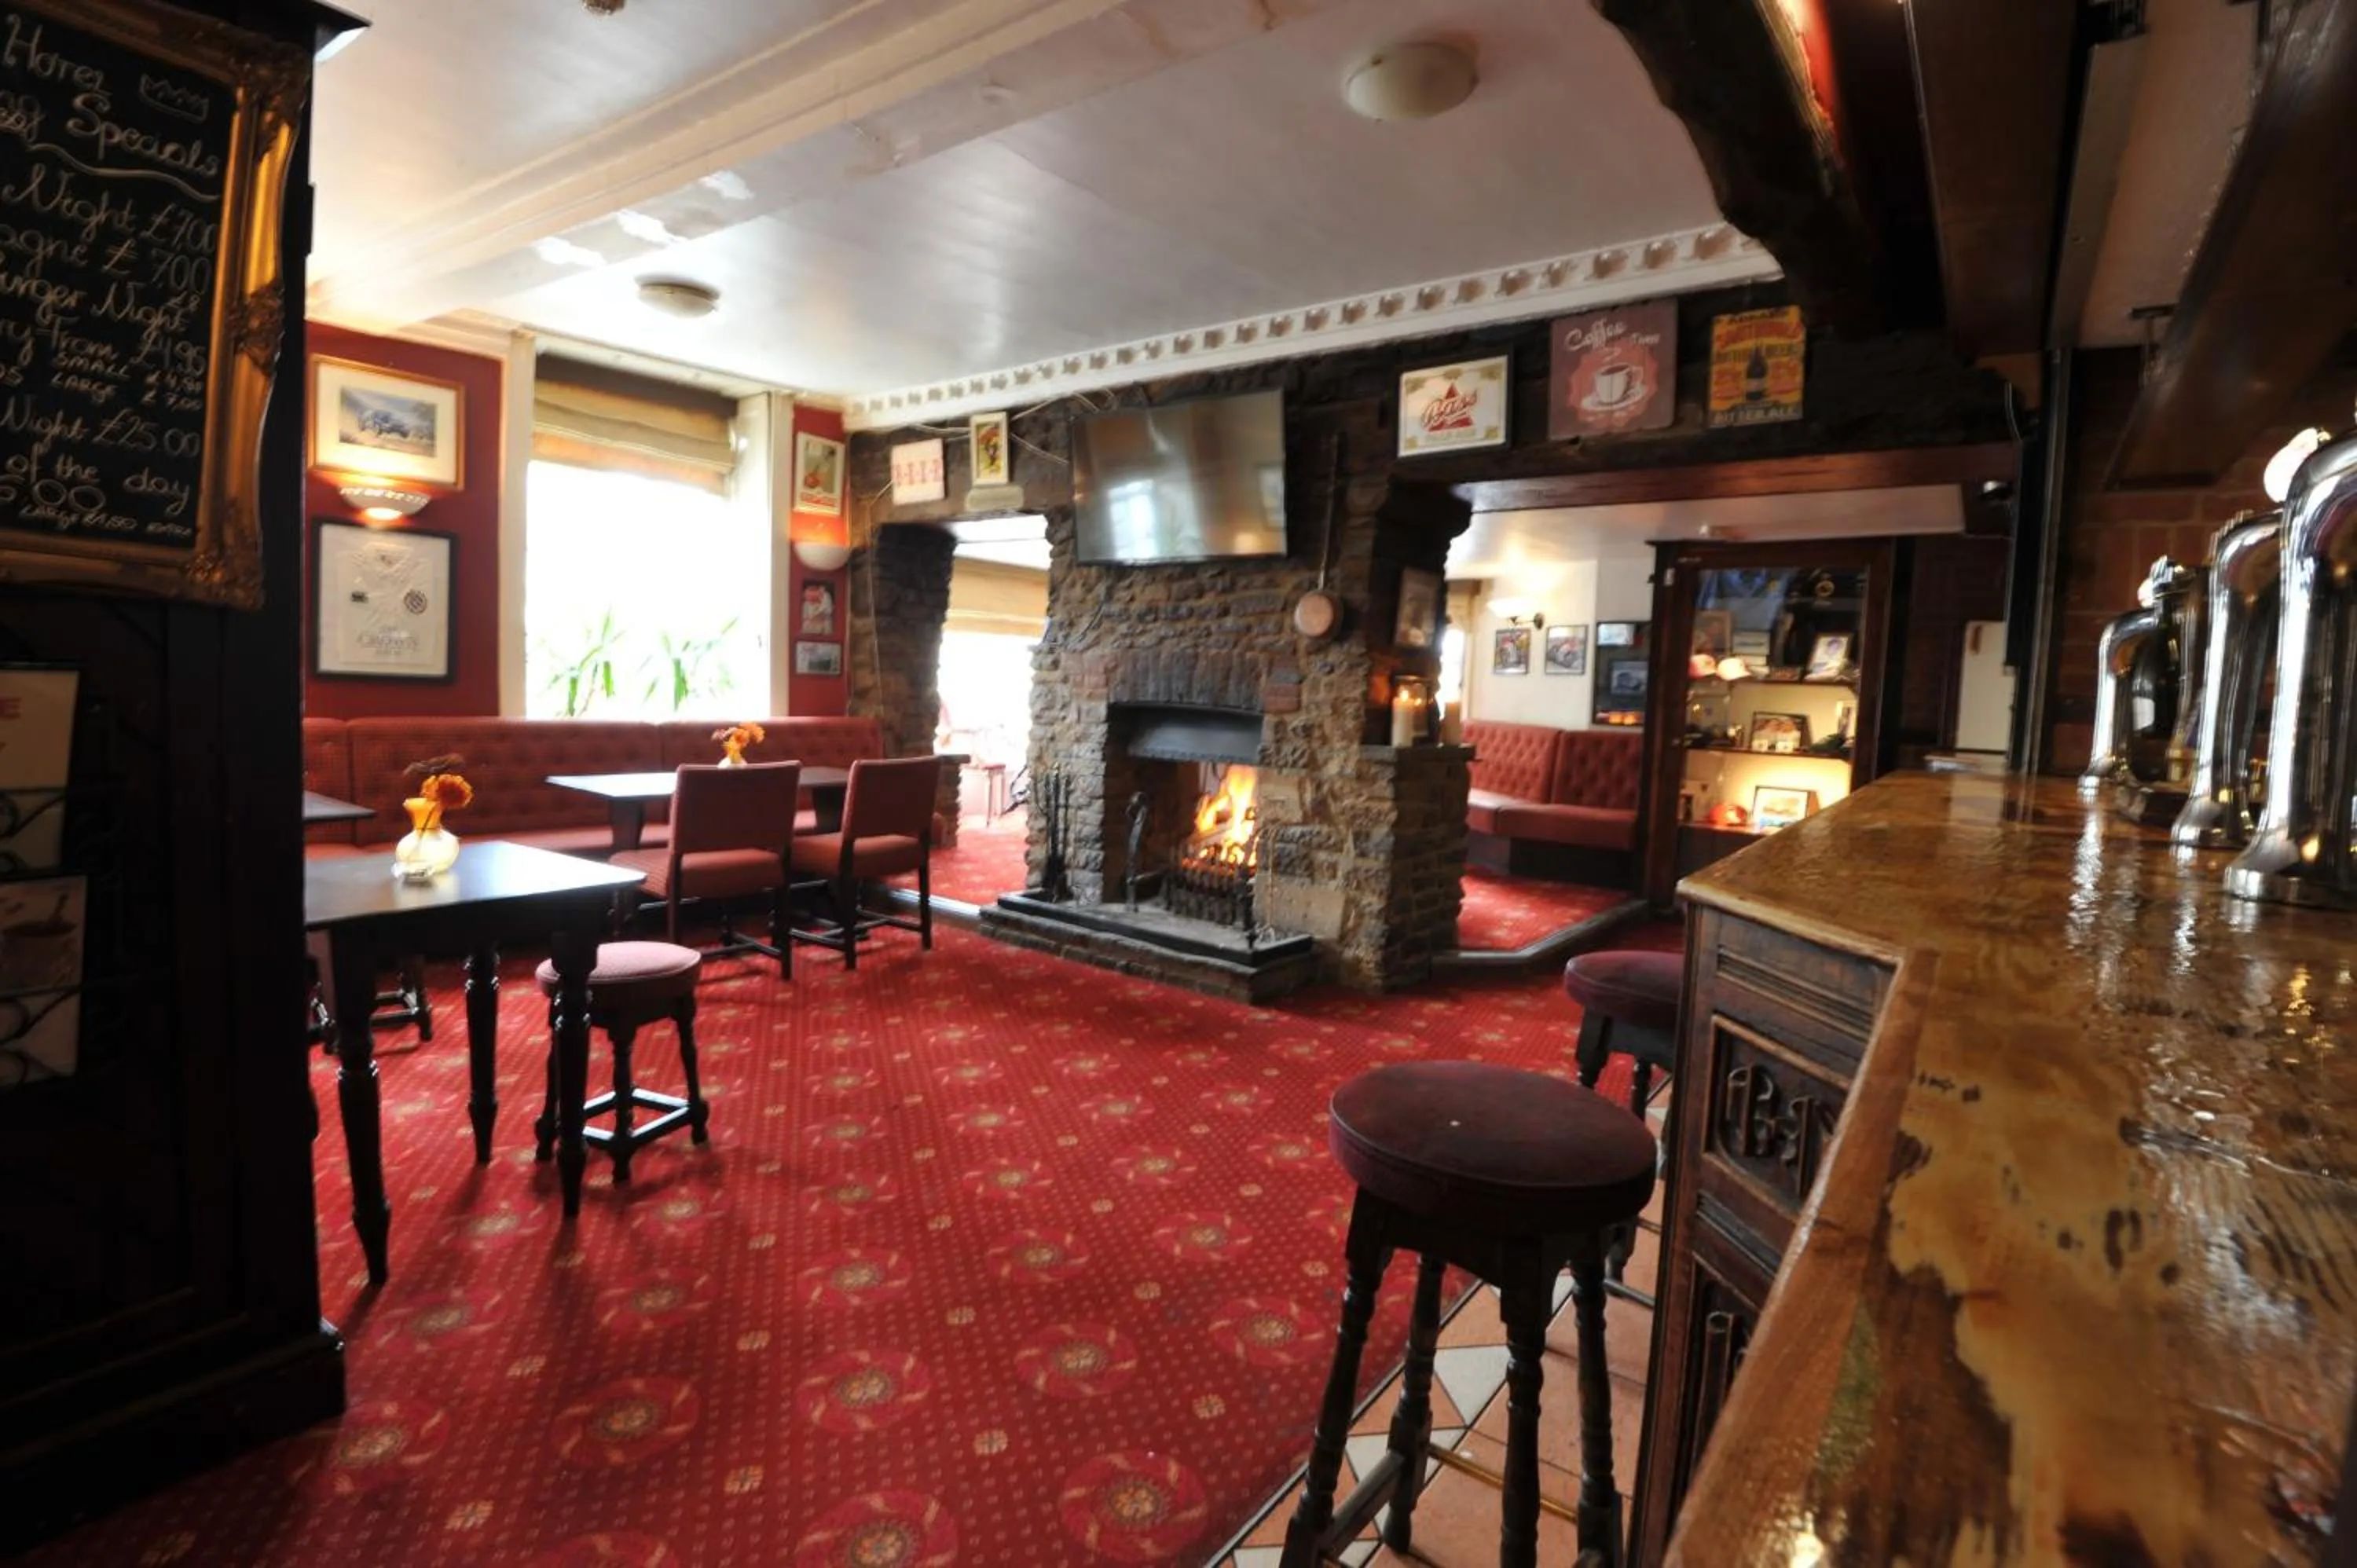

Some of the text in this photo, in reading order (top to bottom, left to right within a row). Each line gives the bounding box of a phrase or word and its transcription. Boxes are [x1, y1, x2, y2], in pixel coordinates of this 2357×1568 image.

[66, 92, 221, 176] Specials
[2, 163, 137, 243] Night
[0, 264, 88, 327] urger
[123, 467, 190, 516] day
